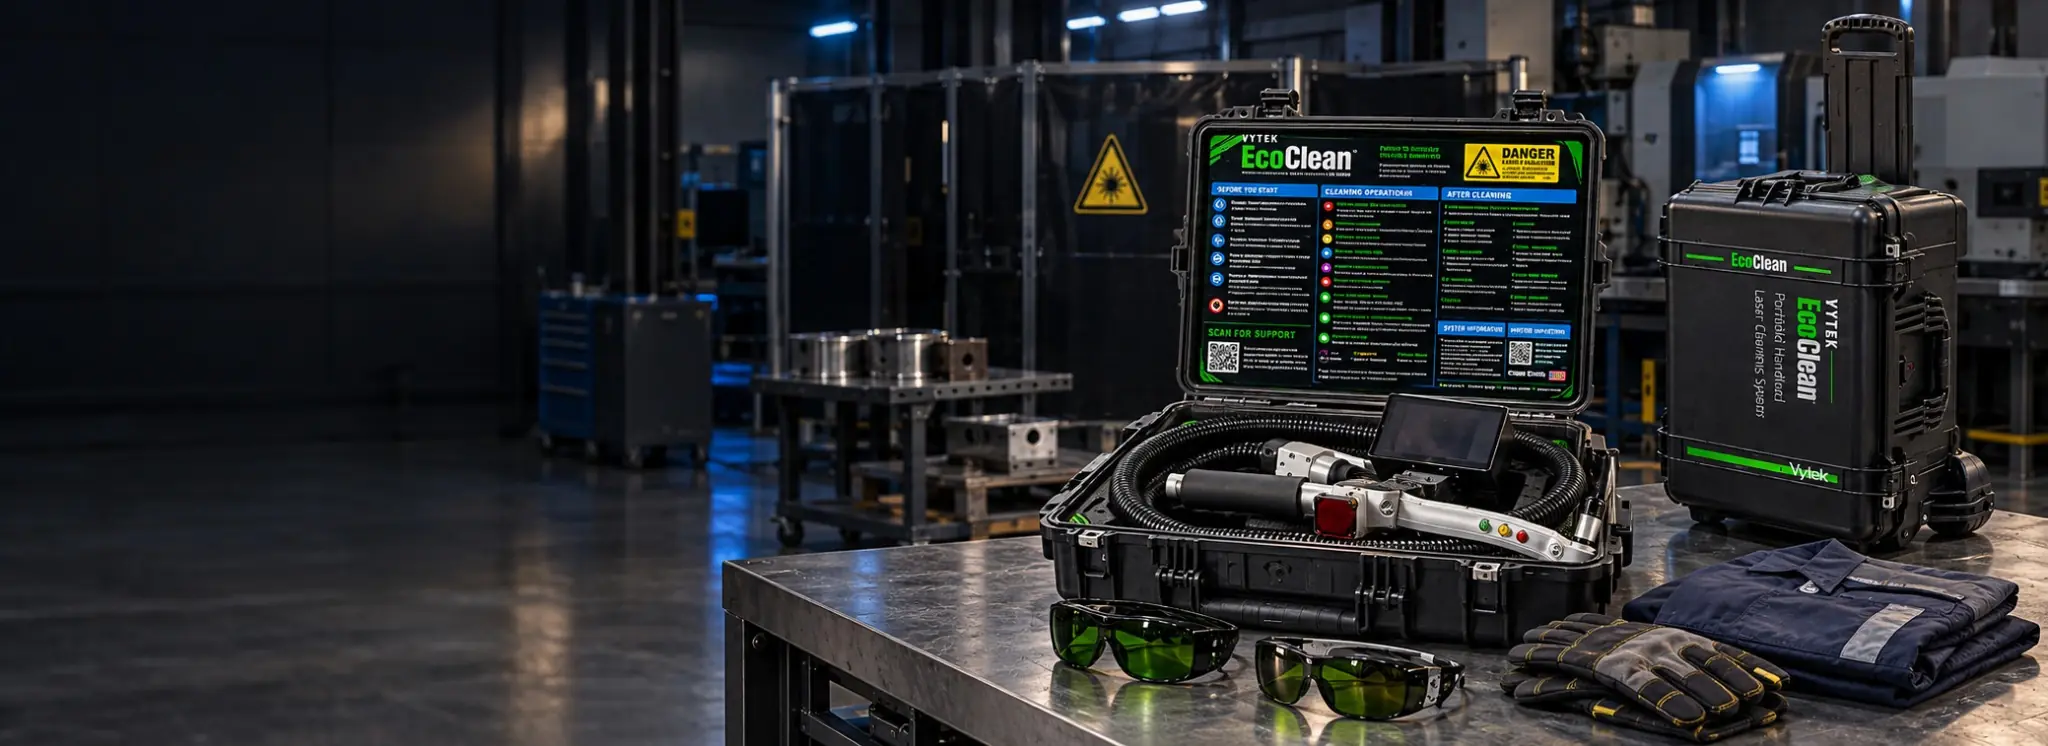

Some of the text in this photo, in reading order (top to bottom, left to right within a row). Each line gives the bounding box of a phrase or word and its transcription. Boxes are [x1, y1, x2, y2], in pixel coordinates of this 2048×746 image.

[1242, 134, 1278, 143] VYTEK
[1242, 145, 1352, 170] EcoClean
[1502, 147, 1555, 159] DANGER
[1447, 190, 1512, 199] AFTER CLEANING
[1731, 252, 1787, 273] EcoClean
[1754, 290, 1766, 322] Laser
[1208, 328, 1231, 337] SCAN
[1234, 329, 1251, 338] FOR
[1825, 299, 1838, 349] VYTEK
[1796, 297, 1822, 401] EcoClean
